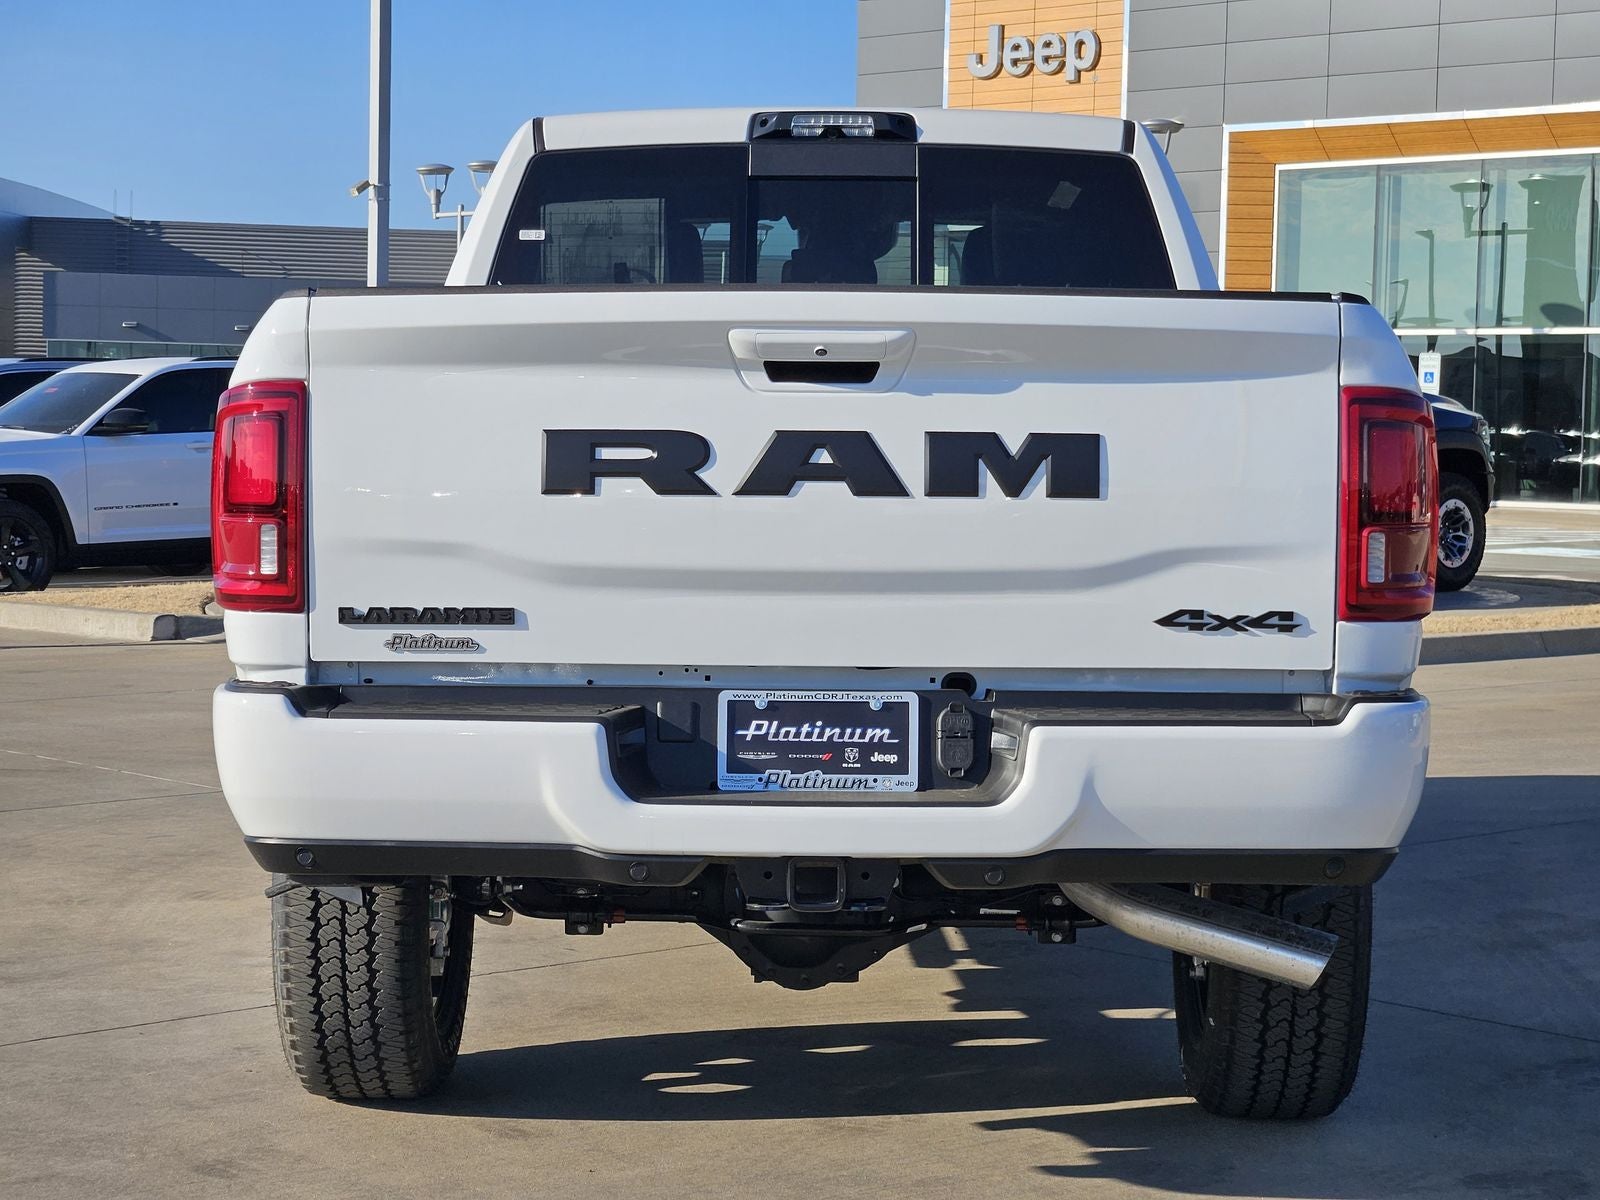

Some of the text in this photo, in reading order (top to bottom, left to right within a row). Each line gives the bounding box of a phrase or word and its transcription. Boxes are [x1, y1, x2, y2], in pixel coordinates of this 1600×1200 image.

[967, 24, 1102, 84] Jeep
[541, 428, 1102, 499] RAM
[338, 606, 515, 625] LARAMIE
[383, 633, 480, 651] Platinum
[732, 692, 903, 700] www.PlatinumCDRJTexas.com
[735, 720, 899, 742] Platinum
[870, 752, 898, 764] Jeep
[763, 773, 876, 789] Platinum
